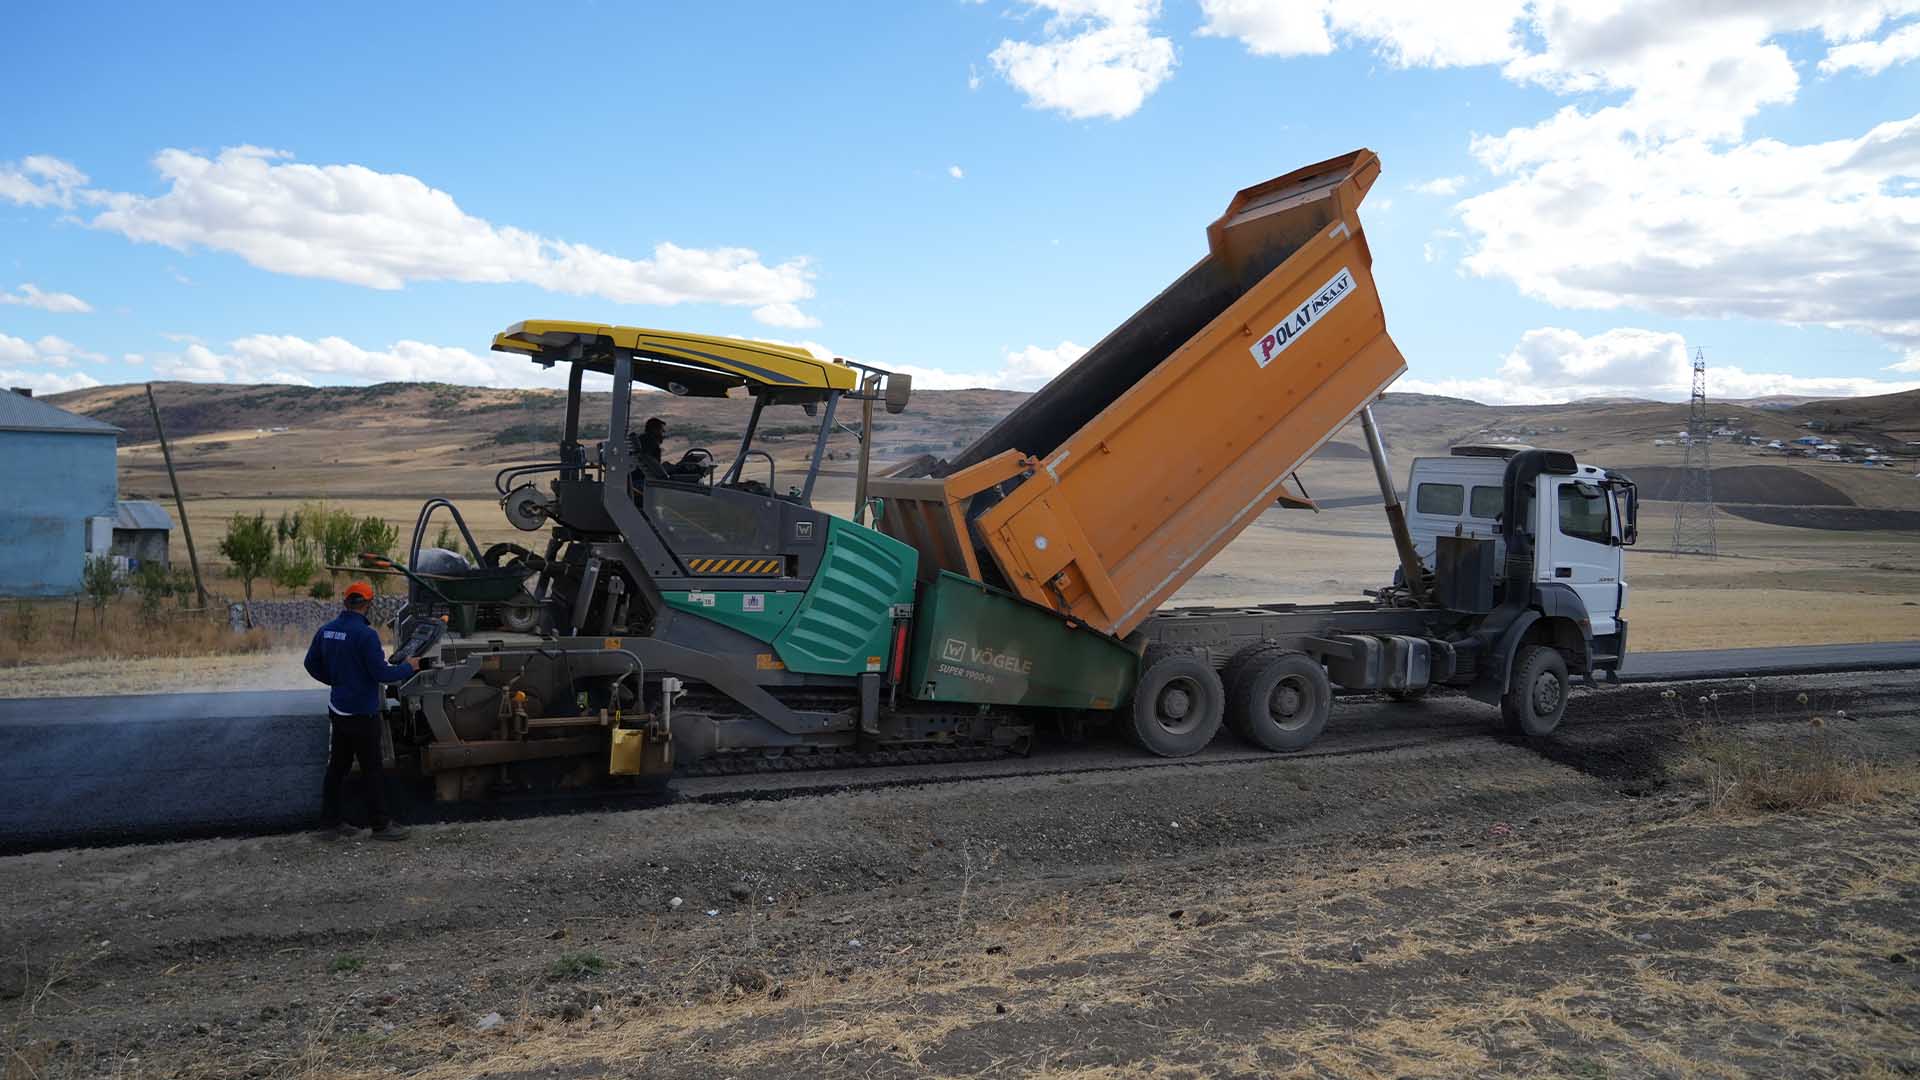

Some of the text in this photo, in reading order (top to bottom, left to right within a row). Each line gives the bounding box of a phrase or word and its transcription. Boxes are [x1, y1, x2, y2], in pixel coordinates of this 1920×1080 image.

[1259, 304, 1310, 362] POLAT
[938, 663, 964, 676] SUPER
[971, 647, 1033, 674] VÖGELE
